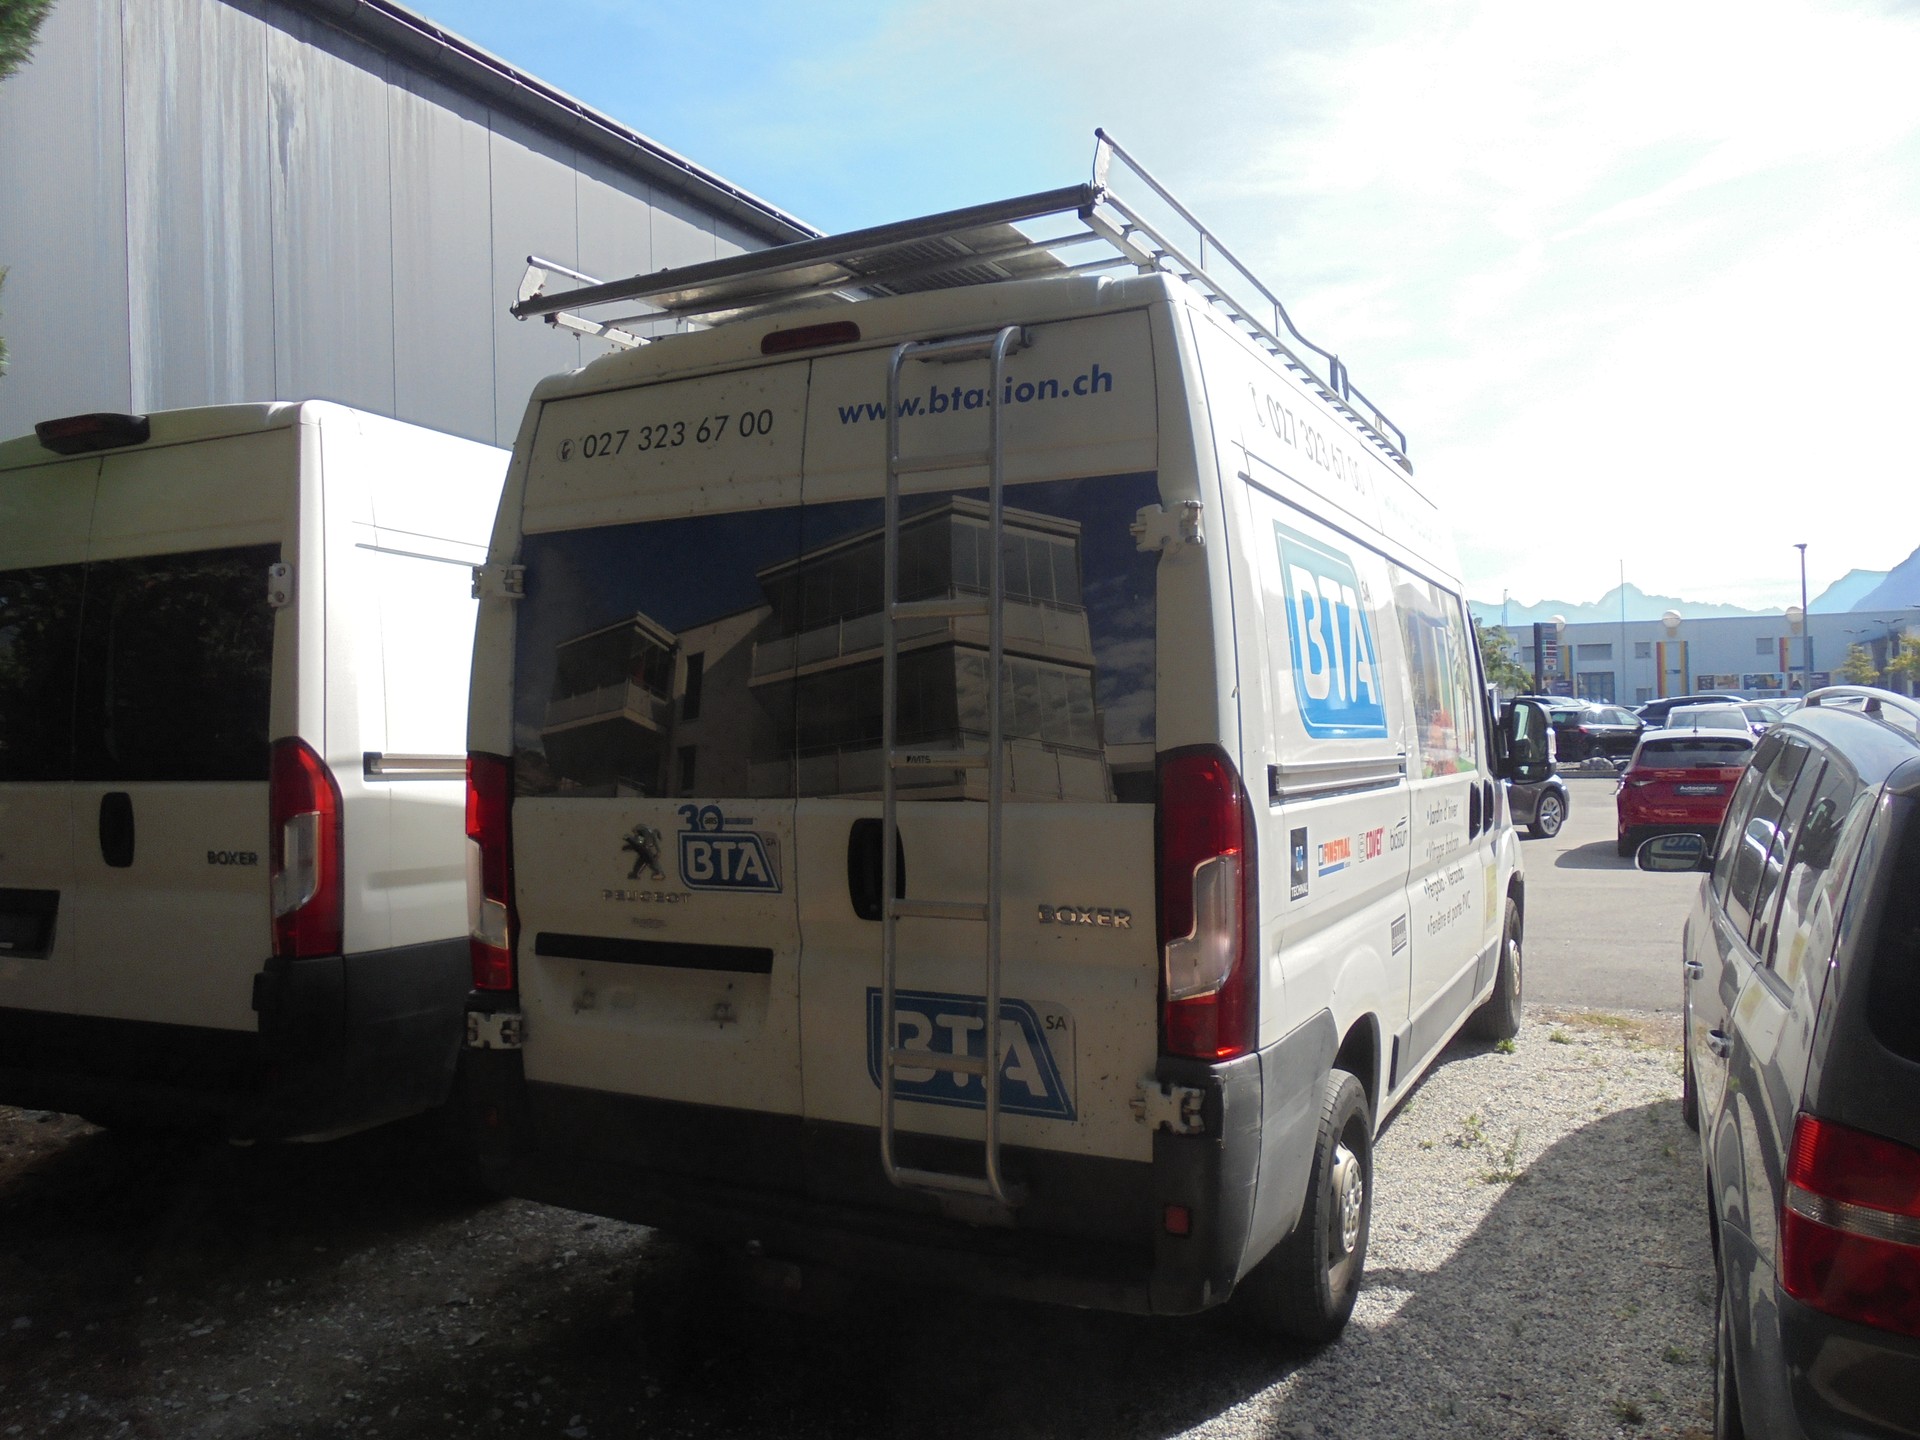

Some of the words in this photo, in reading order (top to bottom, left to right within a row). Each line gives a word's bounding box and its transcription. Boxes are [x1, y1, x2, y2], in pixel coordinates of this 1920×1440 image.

[582, 428, 630, 460] 027
[637, 420, 686, 452] 323
[694, 416, 726, 443] 67
[739, 408, 774, 438] 00
[1266, 393, 1297, 449] 027
[1300, 419, 1331, 472] 323
[1289, 563, 1376, 705] BTA
[207, 850, 258, 866] BOXER
[686, 840, 769, 883] BTA
[602, 889, 692, 904] PEUGEOT
[1038, 904, 1132, 929] BOXER
[1045, 1014, 1067, 1031] SA
[892, 1009, 1049, 1098] BTA
